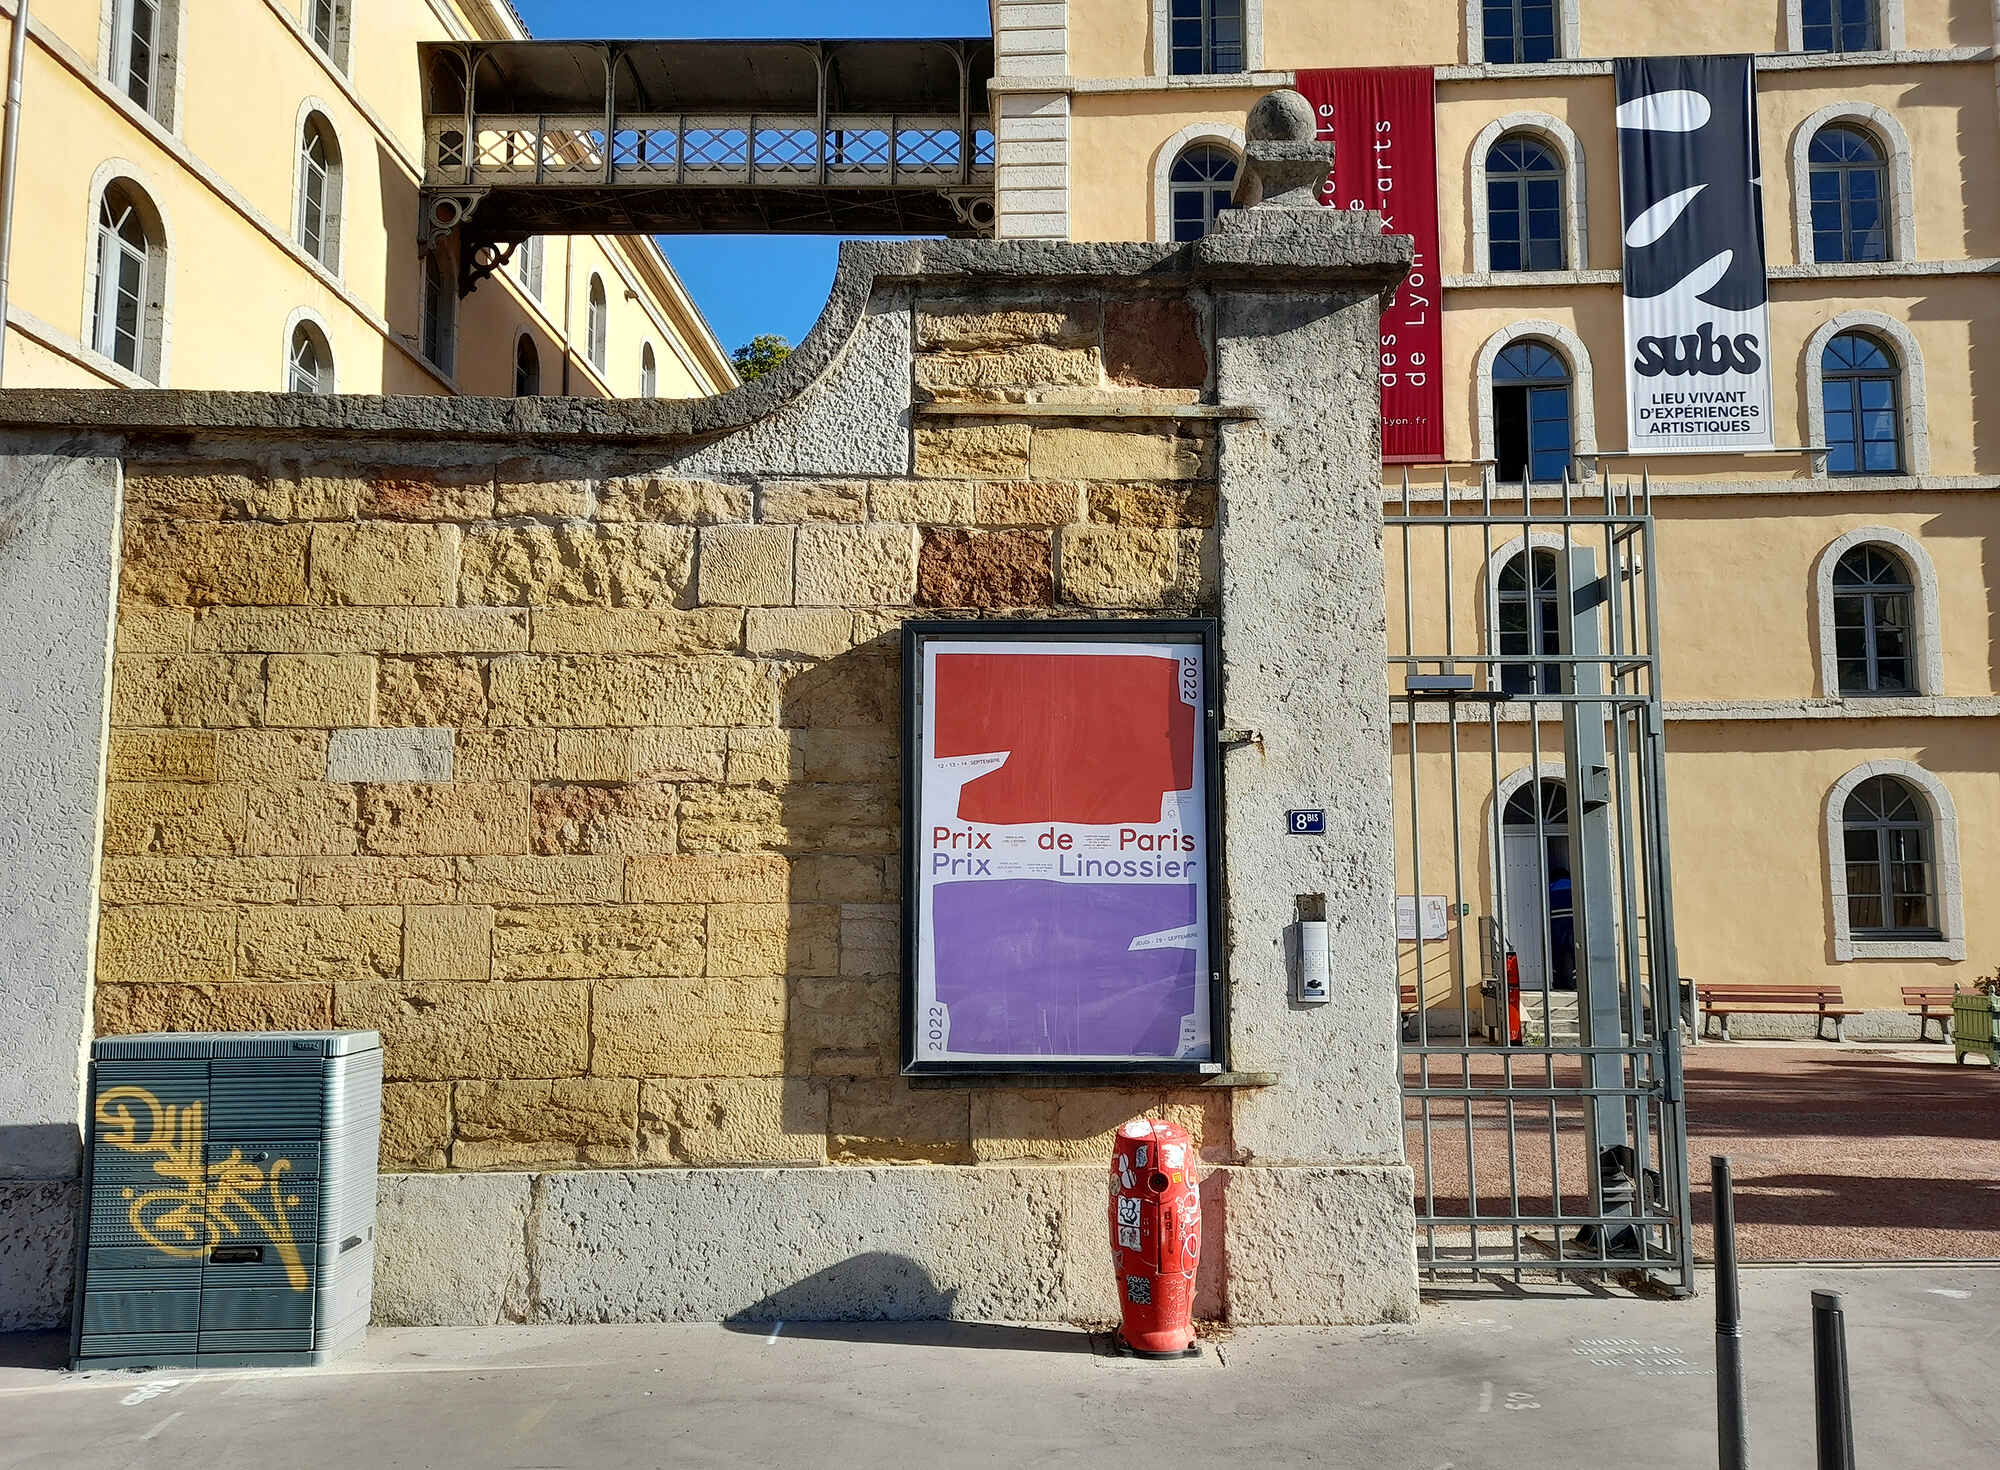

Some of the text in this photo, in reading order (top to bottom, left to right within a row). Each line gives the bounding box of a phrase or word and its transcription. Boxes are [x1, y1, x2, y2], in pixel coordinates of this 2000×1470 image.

[1373, 120, 1397, 387] des x-arts
[1405, 253, 1429, 387] de Lyon
[1634, 321, 1762, 377] subs
[1652, 391, 1746, 405] LIEU VIVANT
[1382, 416, 1428, 427] lyon.fr
[1649, 420, 1750, 434] ARTISTIQUES
[1184, 656, 1197, 700] 2022
[933, 826, 993, 850] Prix
[1038, 826, 1074, 851] de
[1120, 828, 1196, 851] Paris
[932, 852, 992, 876] Prix
[1059, 854, 1197, 878] Linossier
[929, 1007, 943, 1051] 2022
